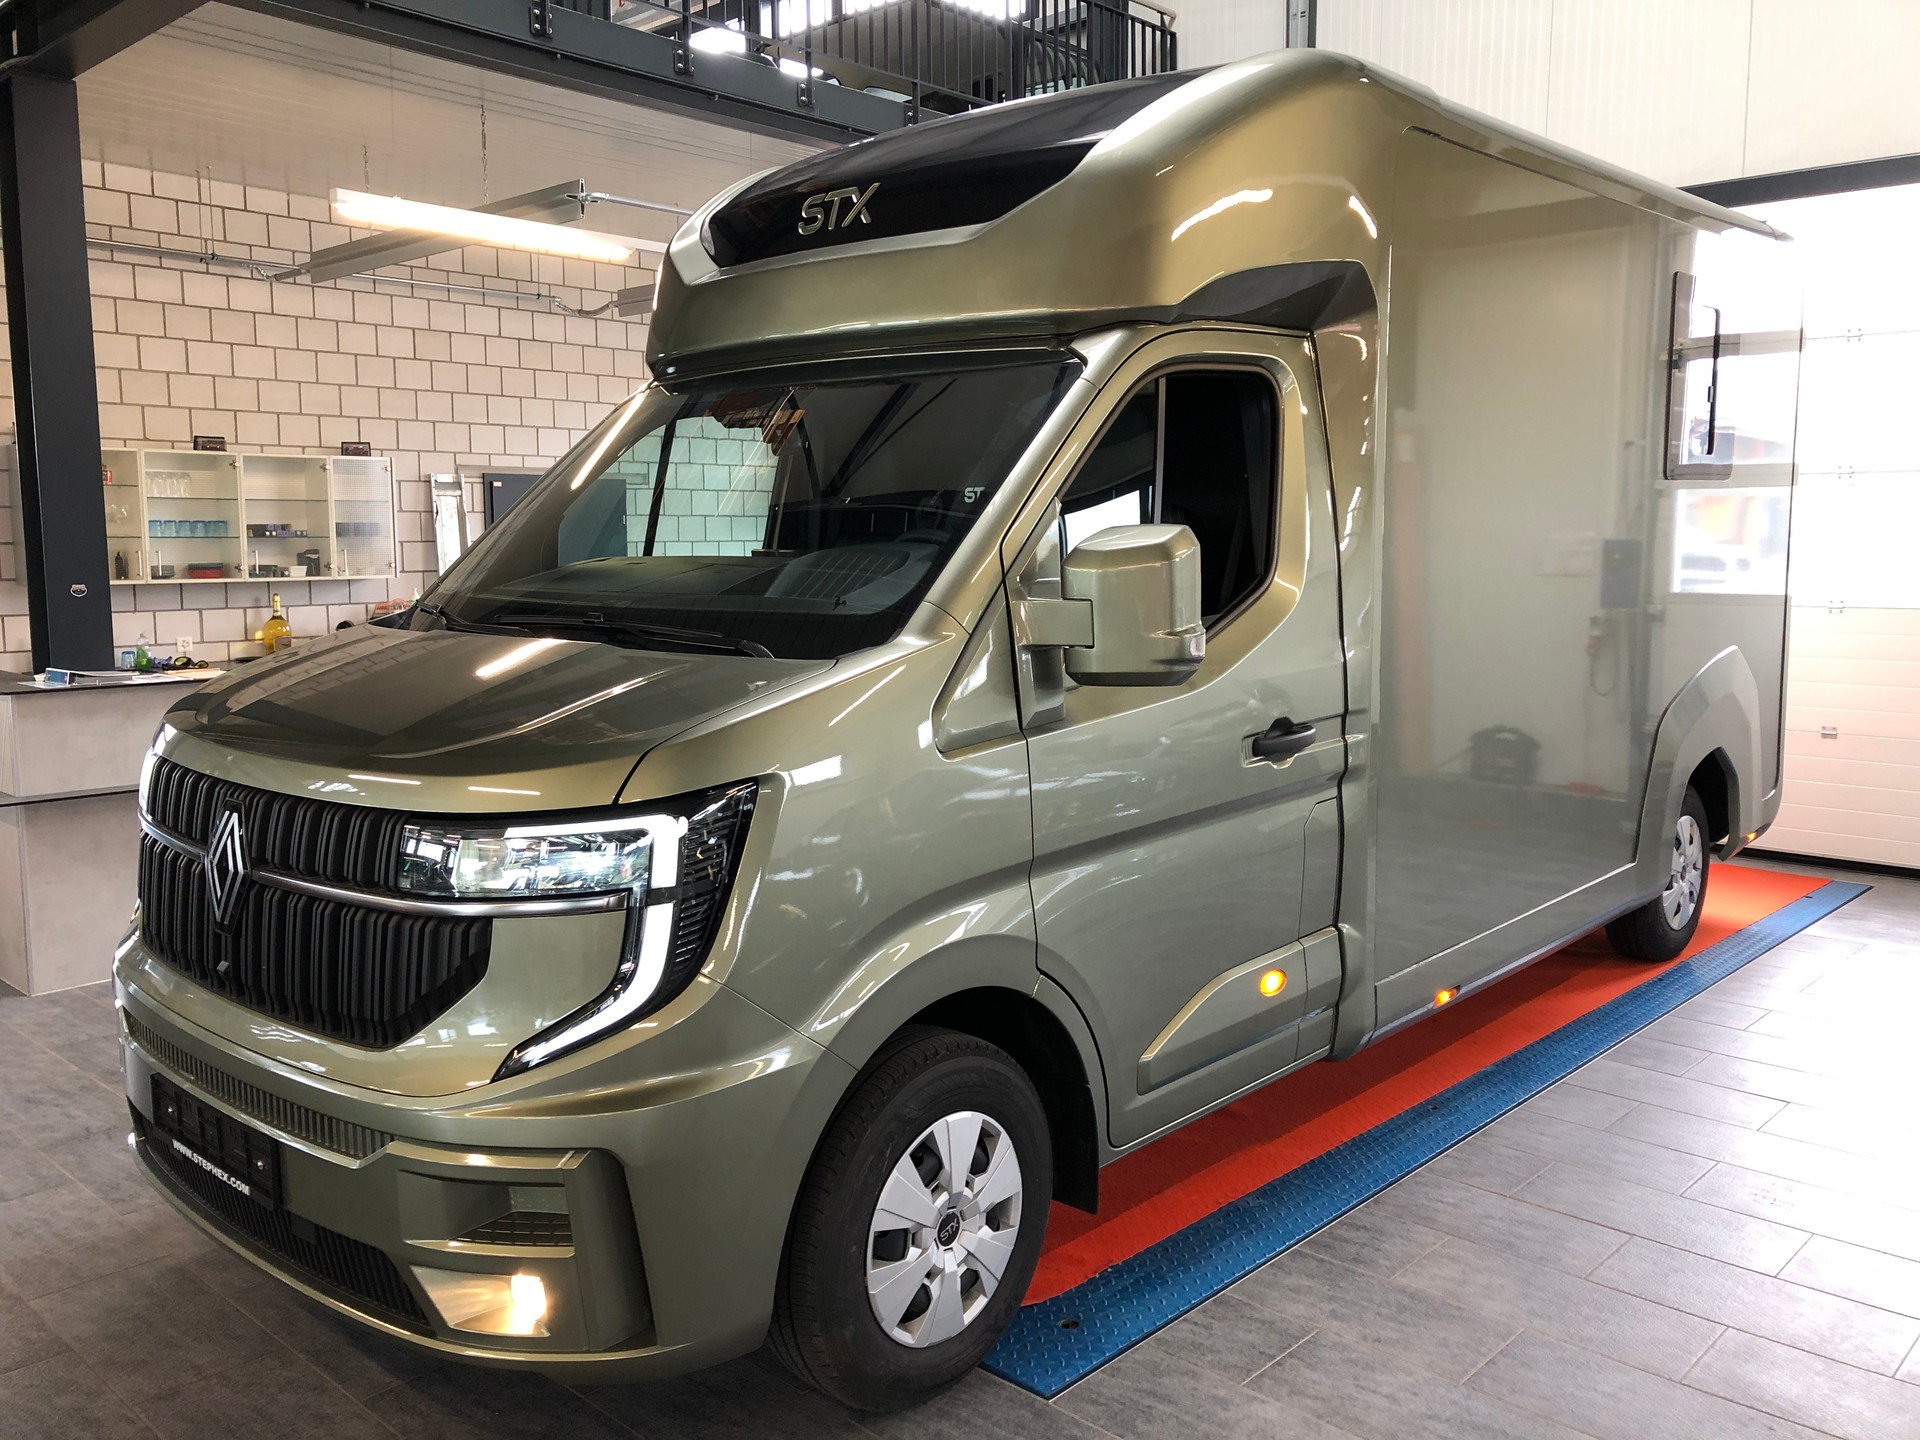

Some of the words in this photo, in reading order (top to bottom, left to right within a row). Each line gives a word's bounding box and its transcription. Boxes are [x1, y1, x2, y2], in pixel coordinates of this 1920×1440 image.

[798, 181, 881, 235] STX
[172, 1139, 250, 1196] WWW.STEPHEX.COM
[940, 1218, 958, 1241] STX
